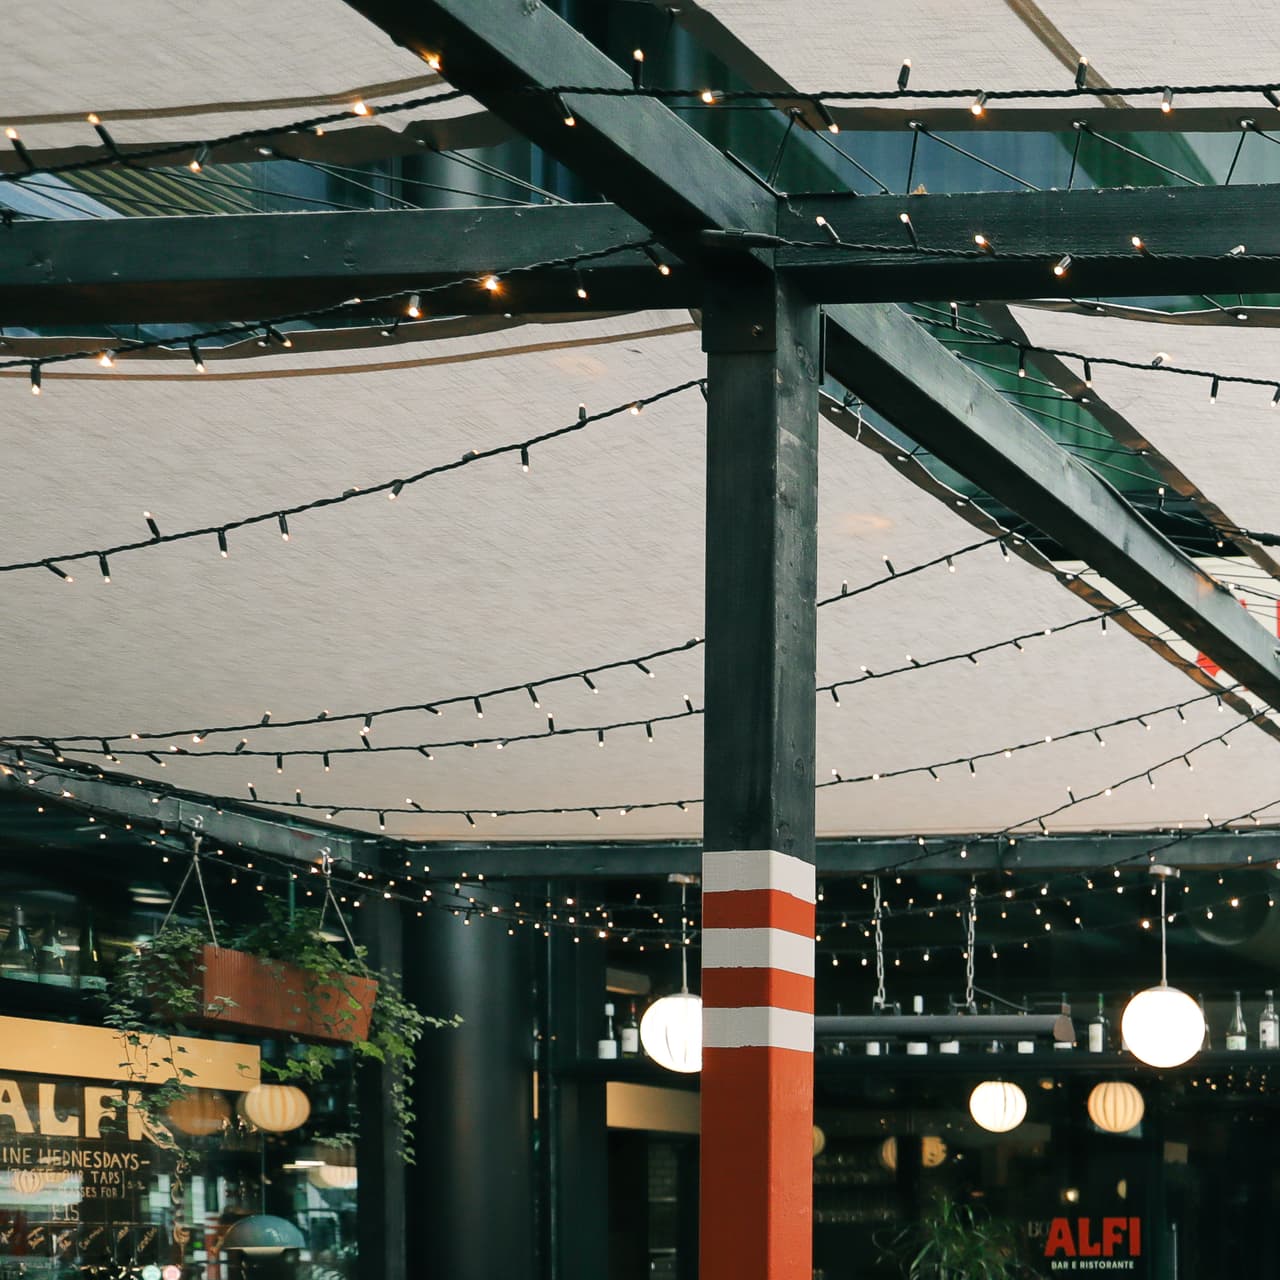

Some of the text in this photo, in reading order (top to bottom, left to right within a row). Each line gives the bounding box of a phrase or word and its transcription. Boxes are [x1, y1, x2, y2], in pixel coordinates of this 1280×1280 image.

[0, 1079, 143, 1141] ALFI
[1044, 1217, 1141, 1257] ALFI
[1051, 1261, 1135, 1270] BAR E RISTORANTE
